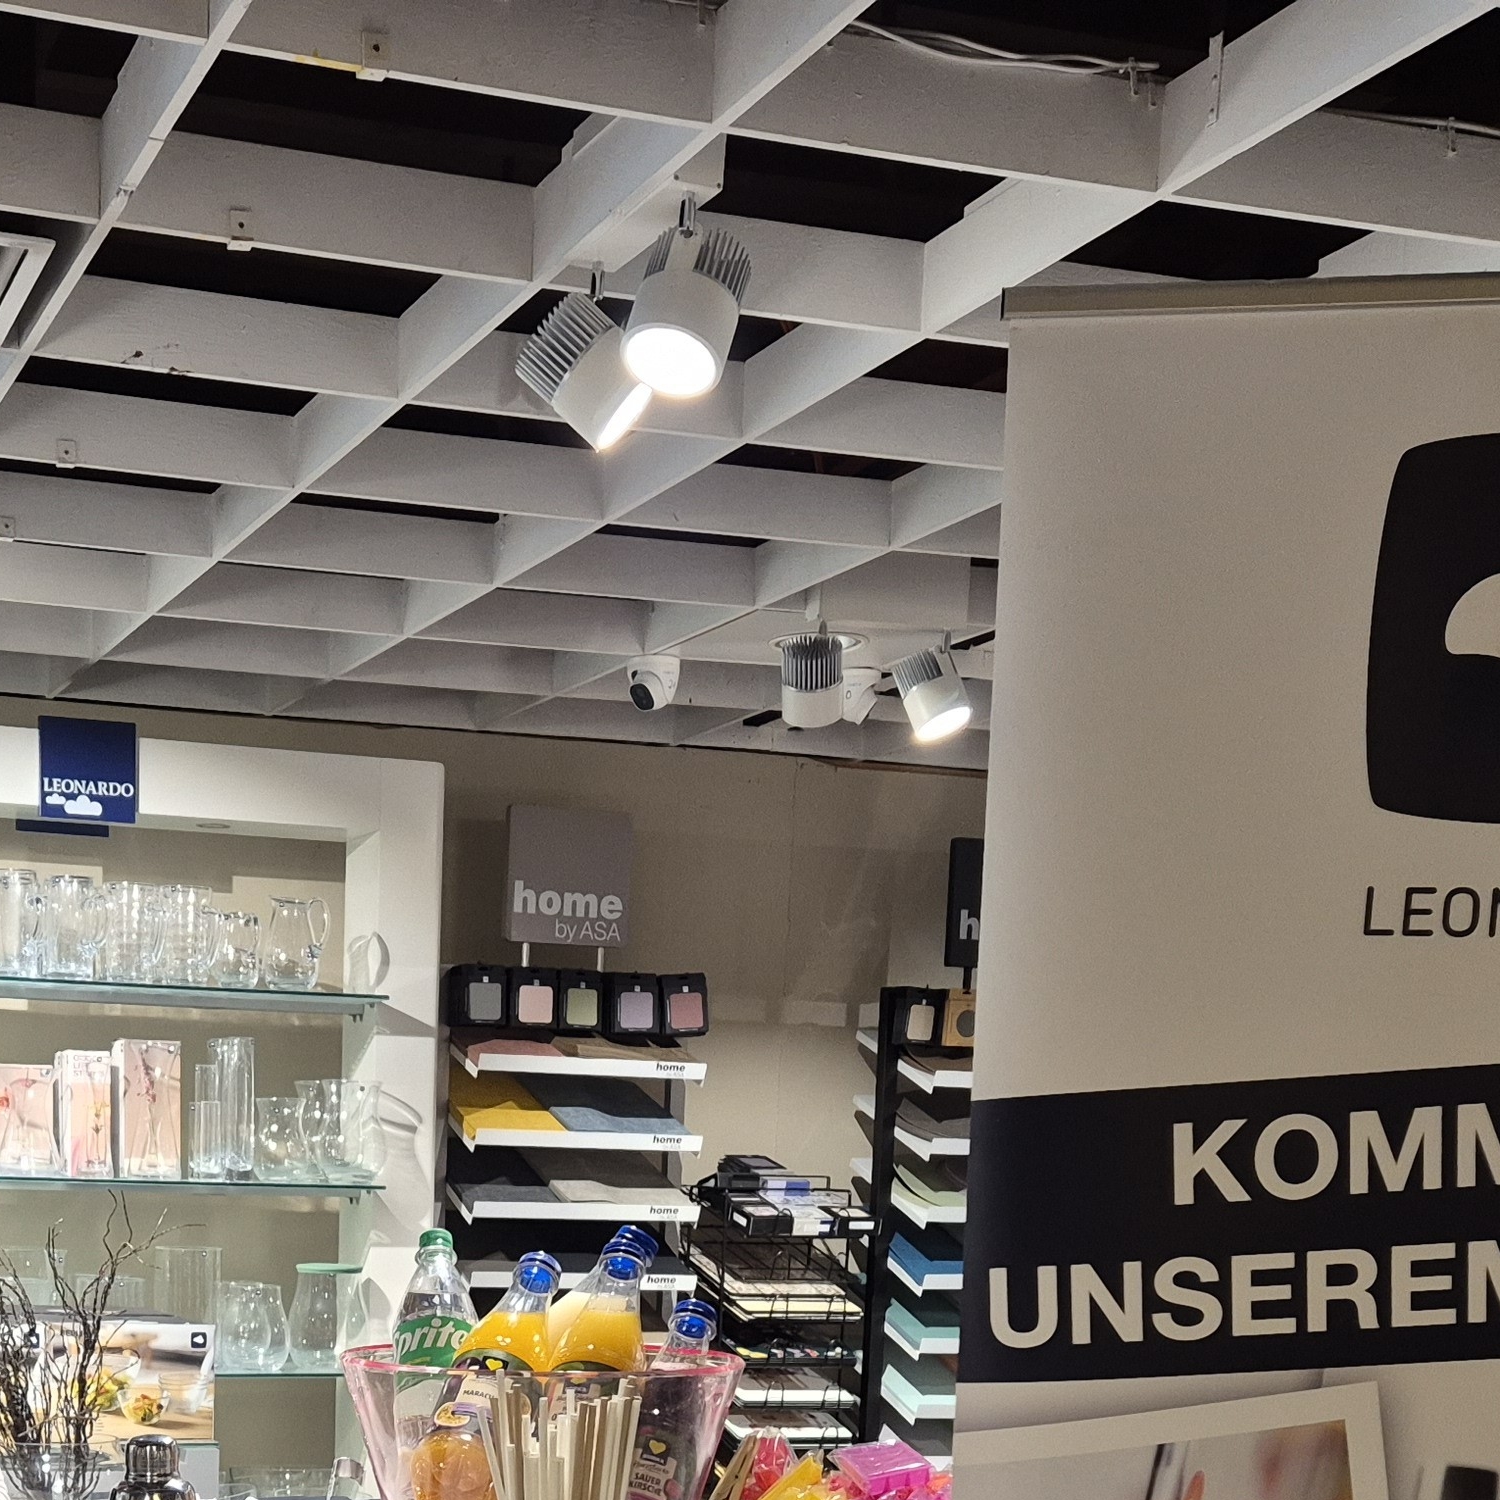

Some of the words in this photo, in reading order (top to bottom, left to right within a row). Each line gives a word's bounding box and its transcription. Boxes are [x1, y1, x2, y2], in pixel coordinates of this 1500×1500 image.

[42, 776, 134, 798] LEONARDO
[512, 879, 624, 920] home
[1363, 886, 1500, 938] LEO
[554, 920, 578, 941] by
[580, 921, 621, 942] ASA
[655, 1062, 686, 1072] home
[652, 1135, 682, 1145] home
[649, 1206, 679, 1216] home
[647, 1275, 677, 1285] home
[395, 1318, 468, 1355] prite
[462, 1388, 498, 1401] MARACU
[633, 1472, 662, 1487] SAUER
